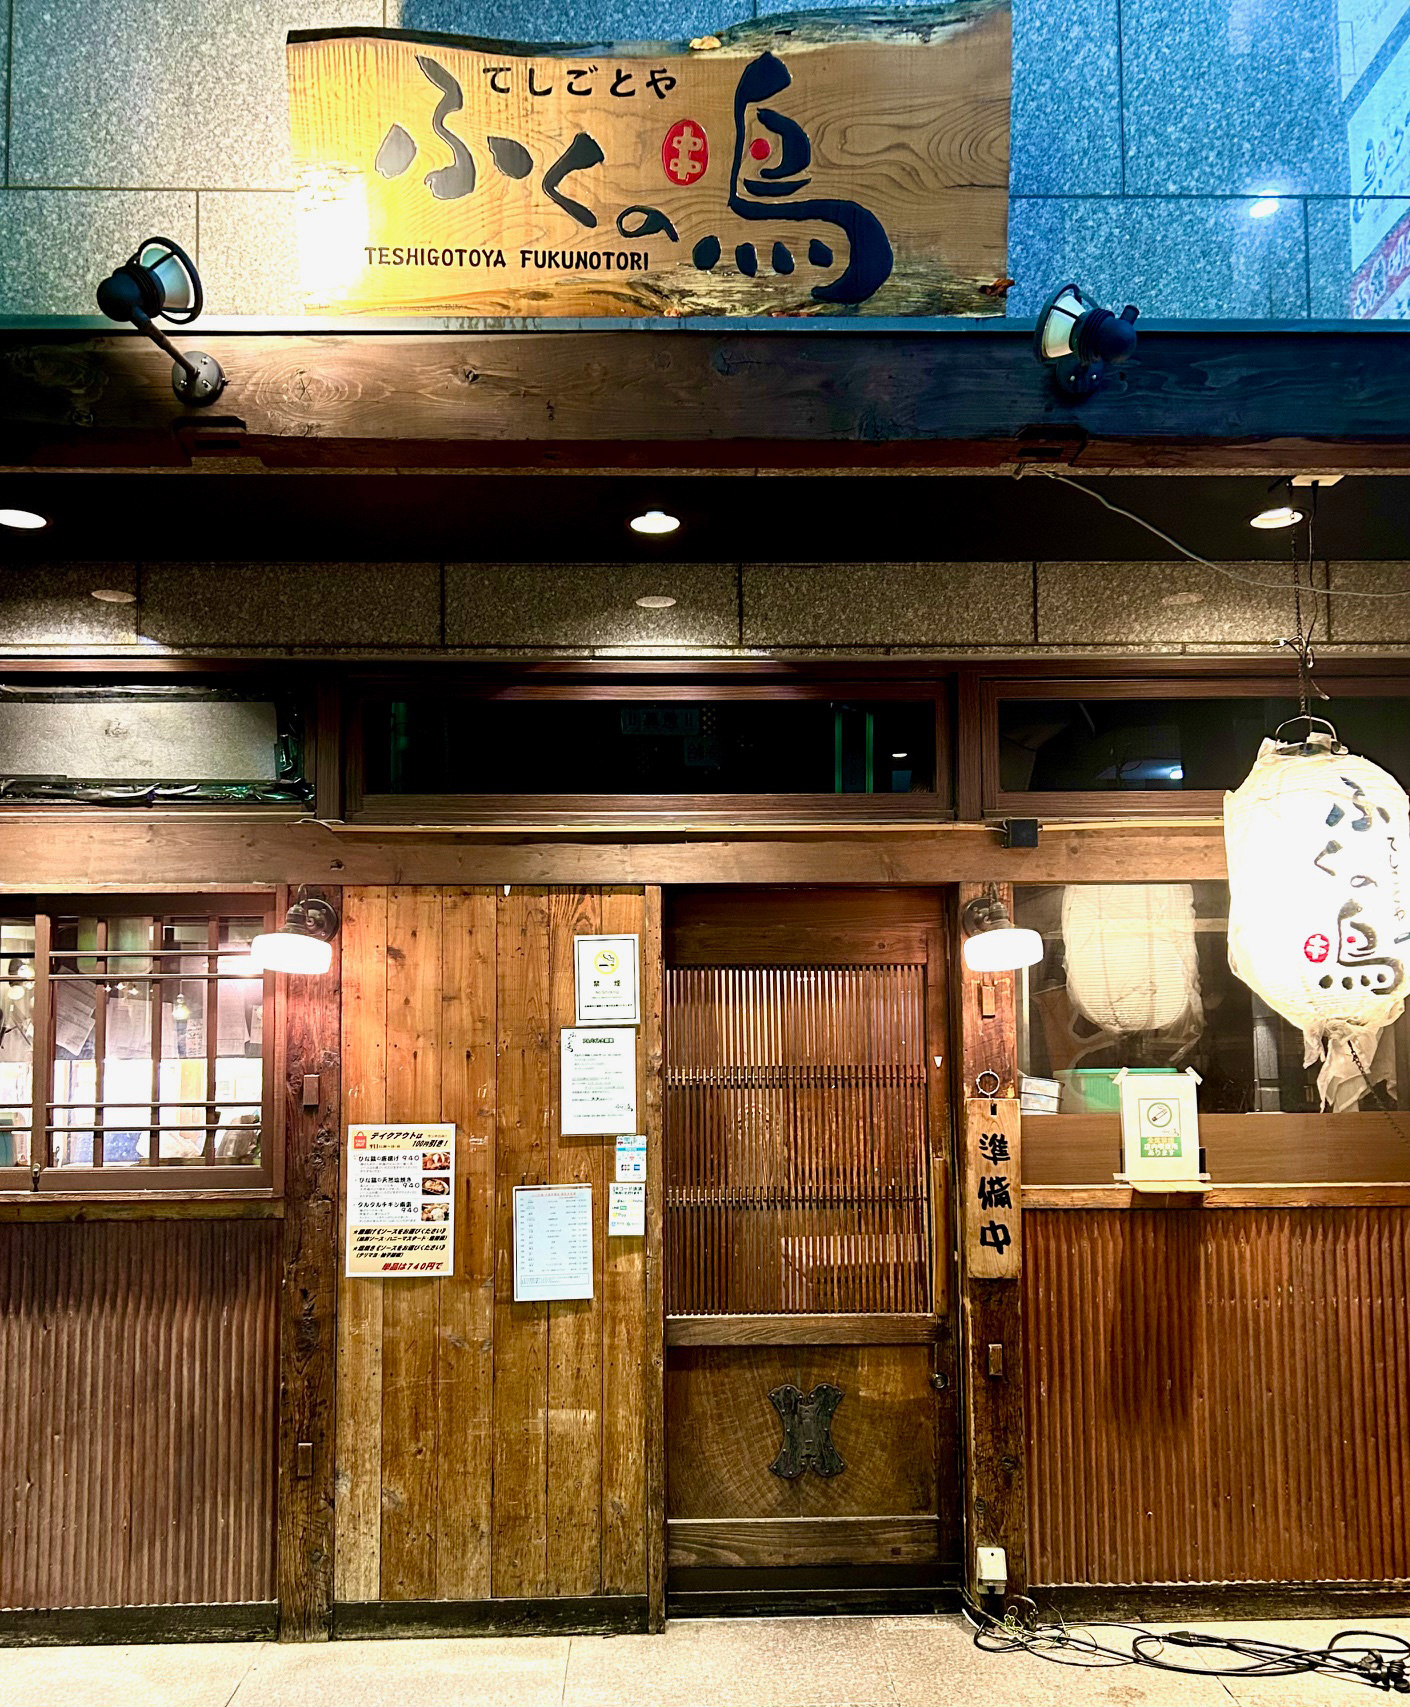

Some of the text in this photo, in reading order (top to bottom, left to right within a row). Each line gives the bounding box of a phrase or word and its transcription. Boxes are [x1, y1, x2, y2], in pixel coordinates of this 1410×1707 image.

[482, 65, 677, 99] てしごとや
[364, 246, 650, 270] TESHIGOTOYA FUKUNOTORI
[370, 1131, 423, 1140] テイクアウトは
[978, 1133, 1012, 1255] 準備中
